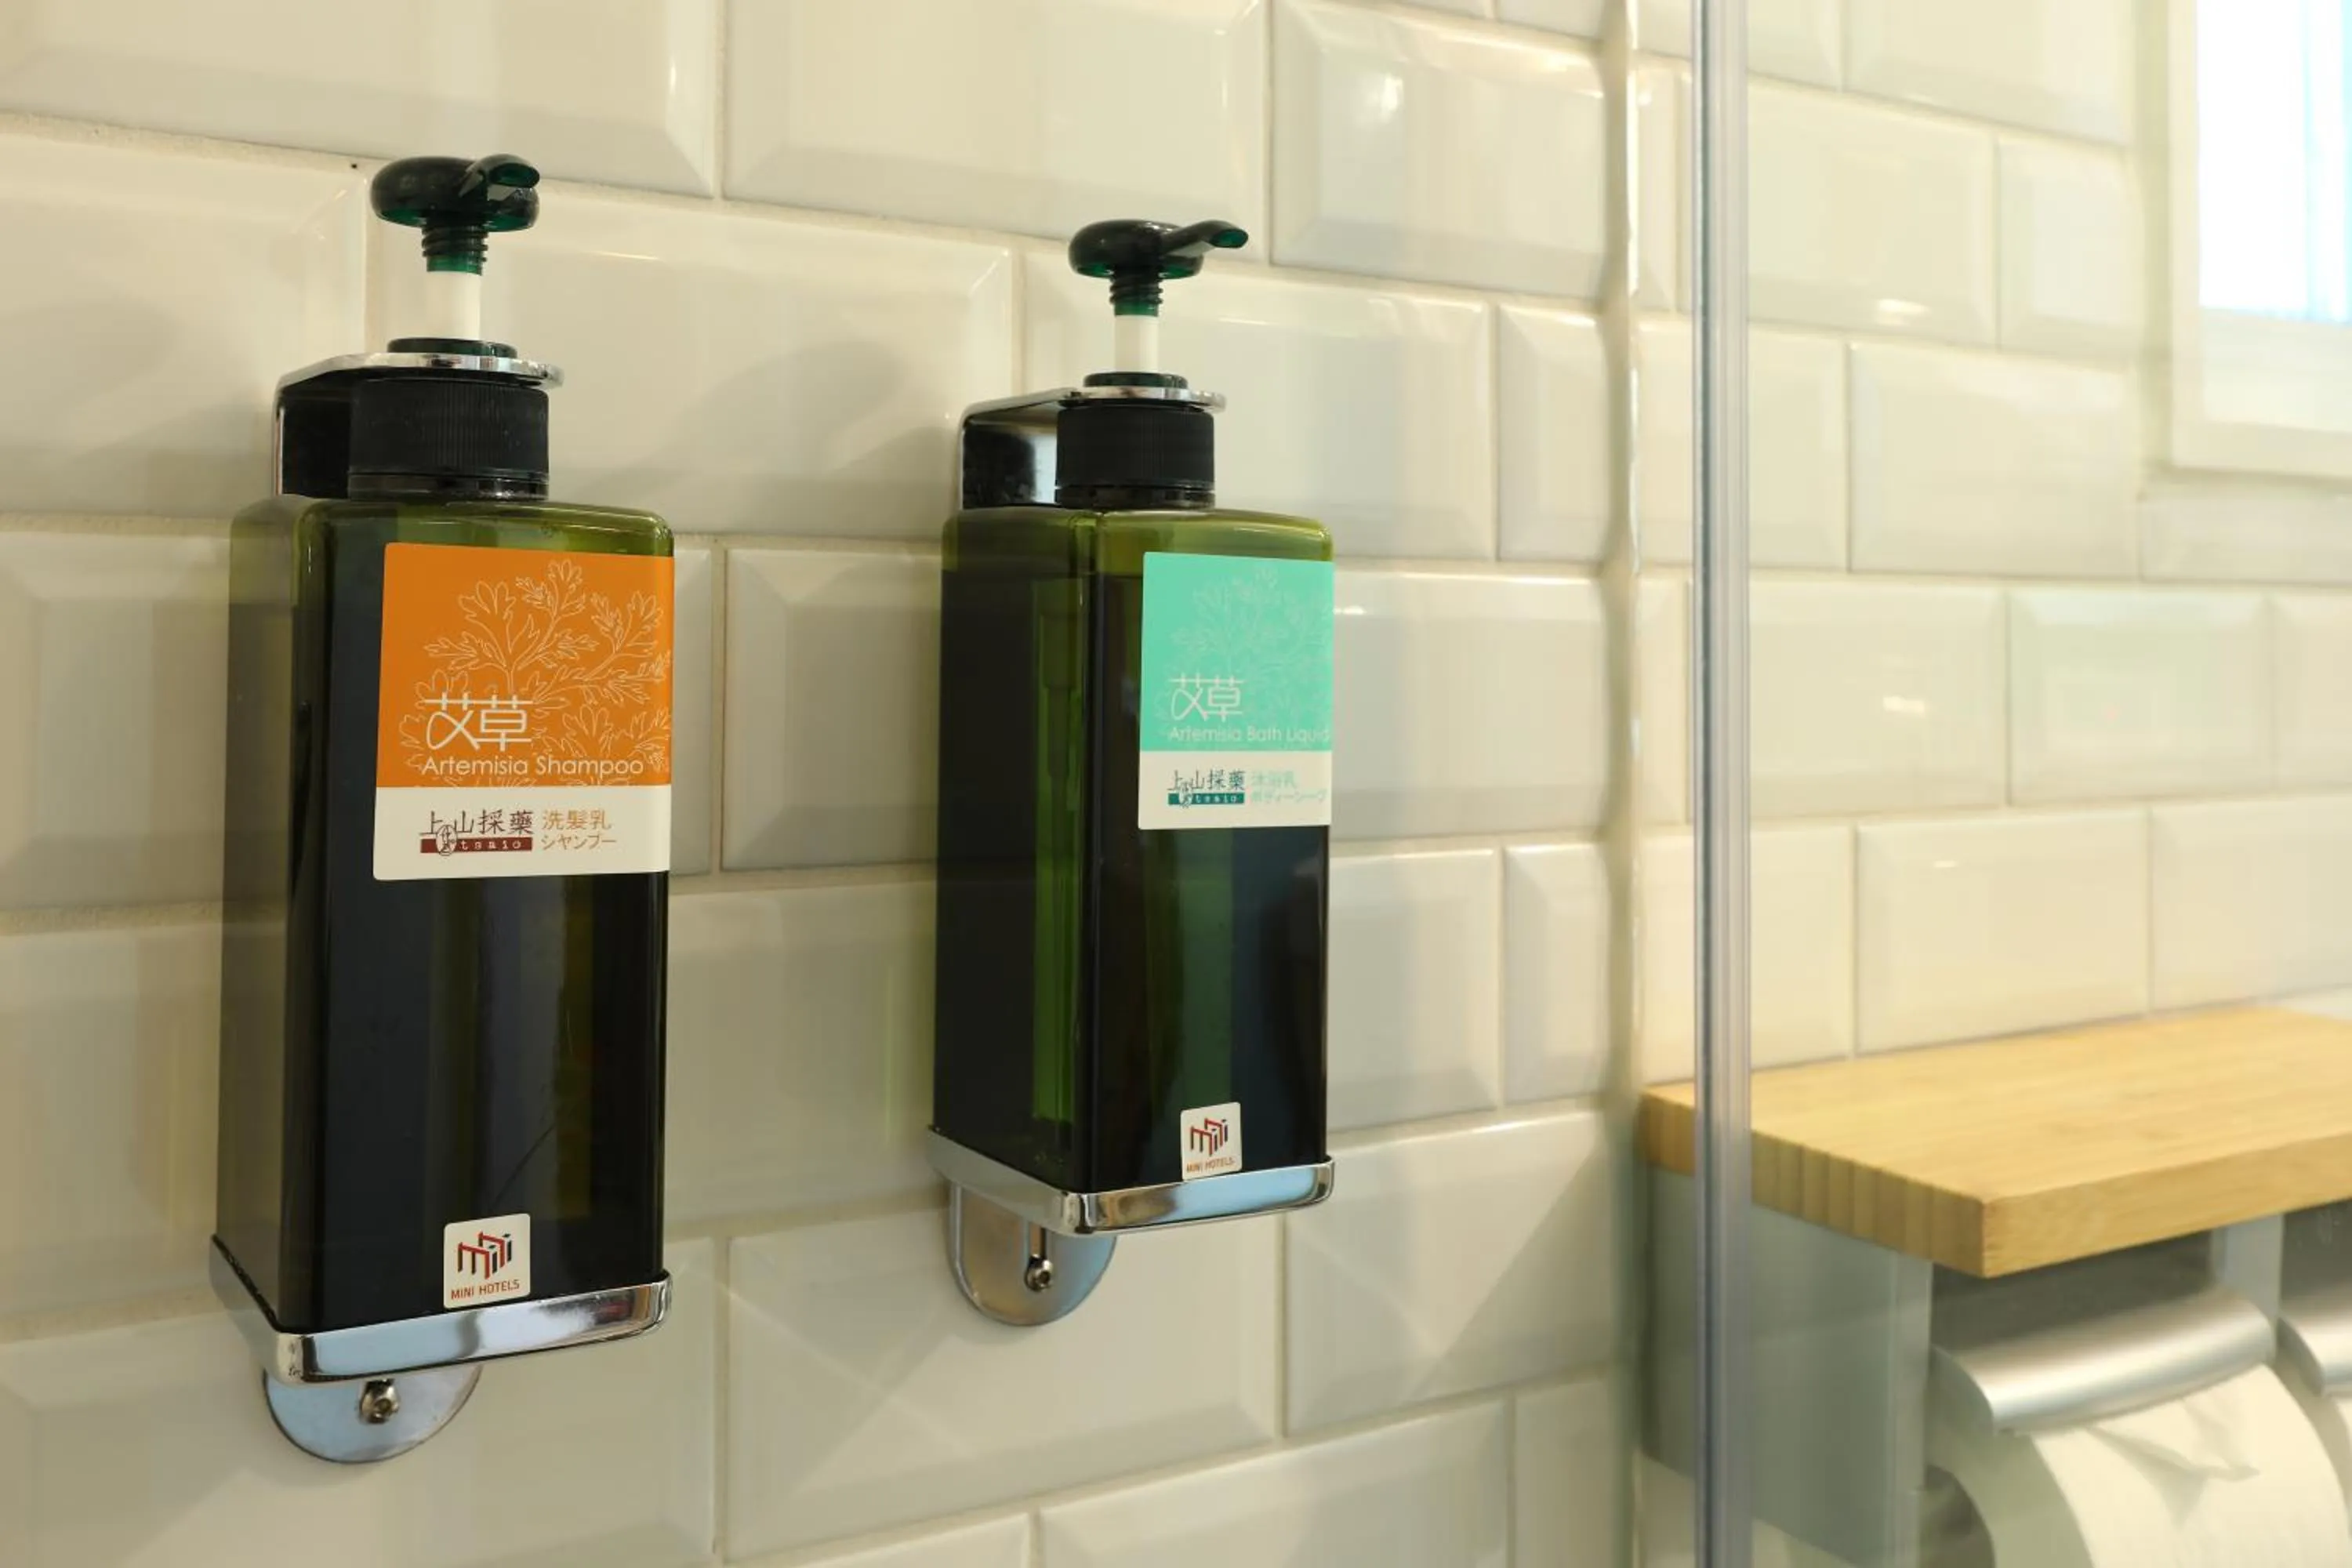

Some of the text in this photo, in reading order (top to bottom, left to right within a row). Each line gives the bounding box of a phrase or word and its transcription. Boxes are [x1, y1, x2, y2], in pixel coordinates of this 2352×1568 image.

[1169, 725, 1241, 742] Artemisia
[1247, 726, 1282, 742] Bath
[422, 755, 644, 778] Artemisia Shampoo
[451, 1279, 520, 1300] MINI HOTELS
